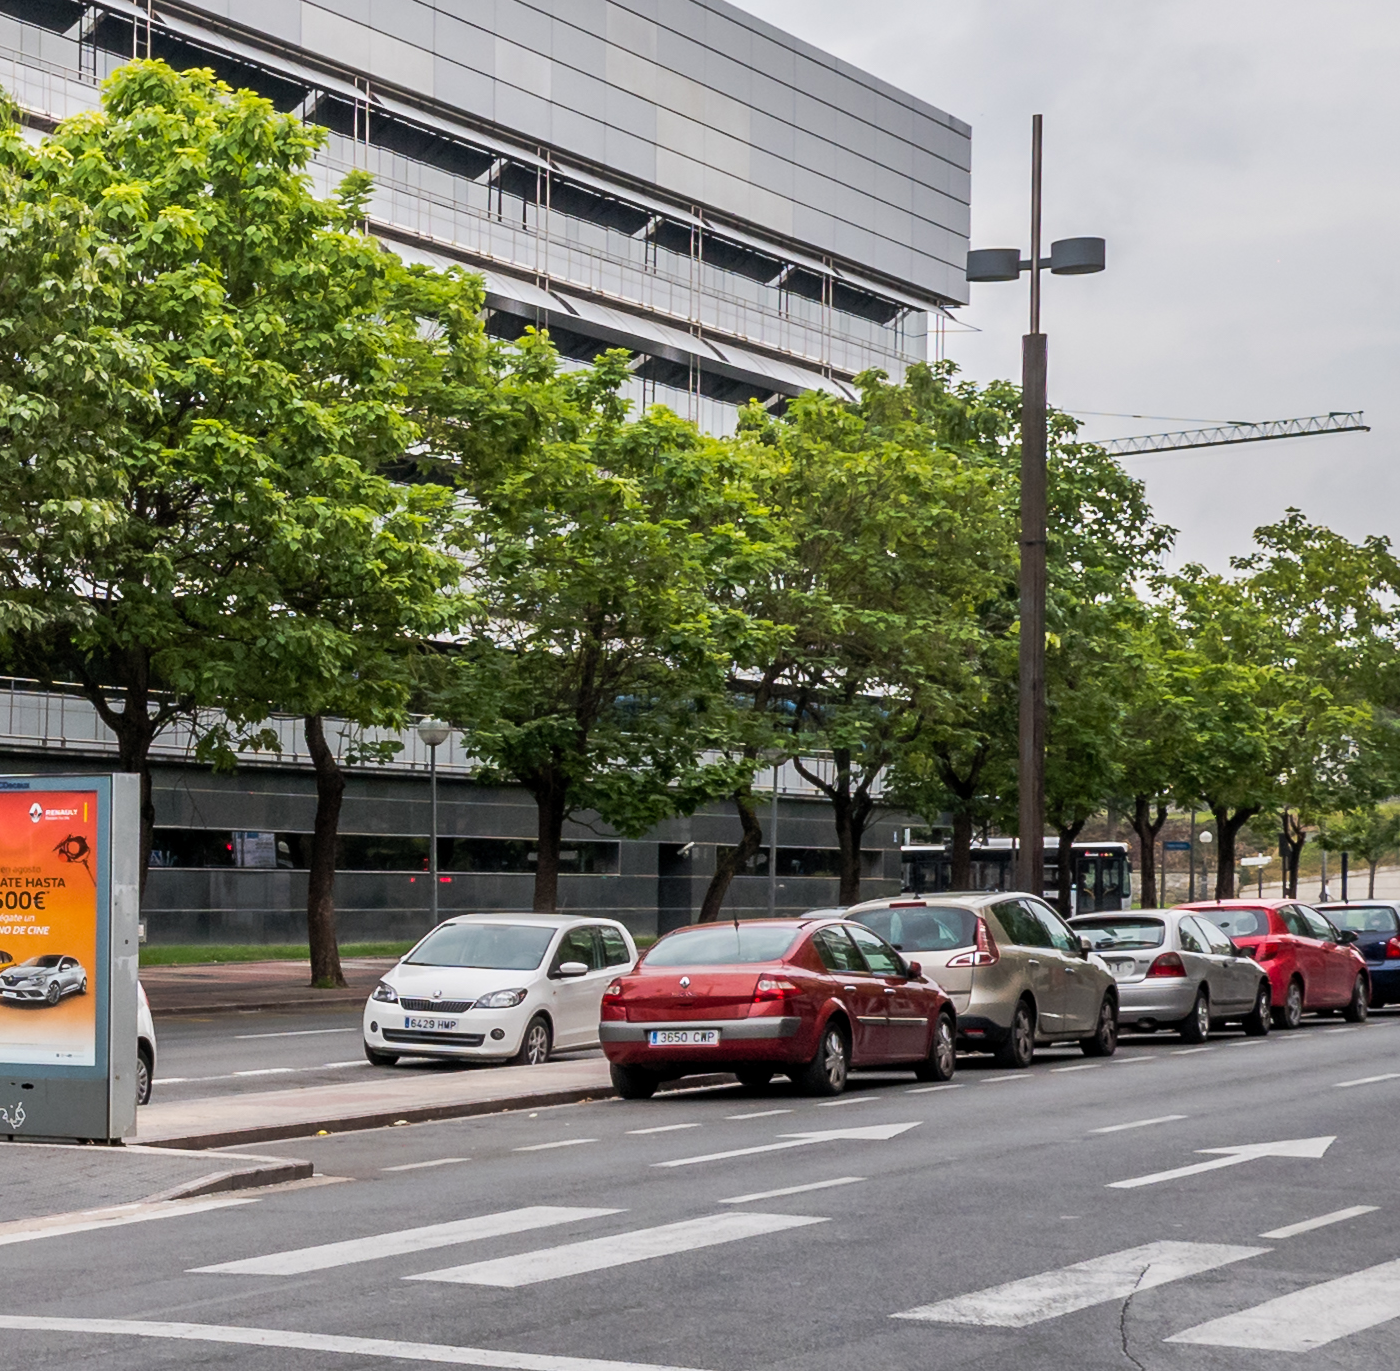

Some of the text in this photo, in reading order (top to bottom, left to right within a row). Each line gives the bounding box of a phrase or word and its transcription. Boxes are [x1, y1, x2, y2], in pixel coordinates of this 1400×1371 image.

[45, 808, 78, 816] RENAULT
[0, 866, 11, 874] en
[12, 865, 42, 875] agosto
[25, 877, 66, 888] HASTA
[12, 925, 28, 935] DE
[27, 926, 51, 936] CINE
[410, 1018, 435, 1029] 6429
[660, 1031, 688, 1043] 3650
